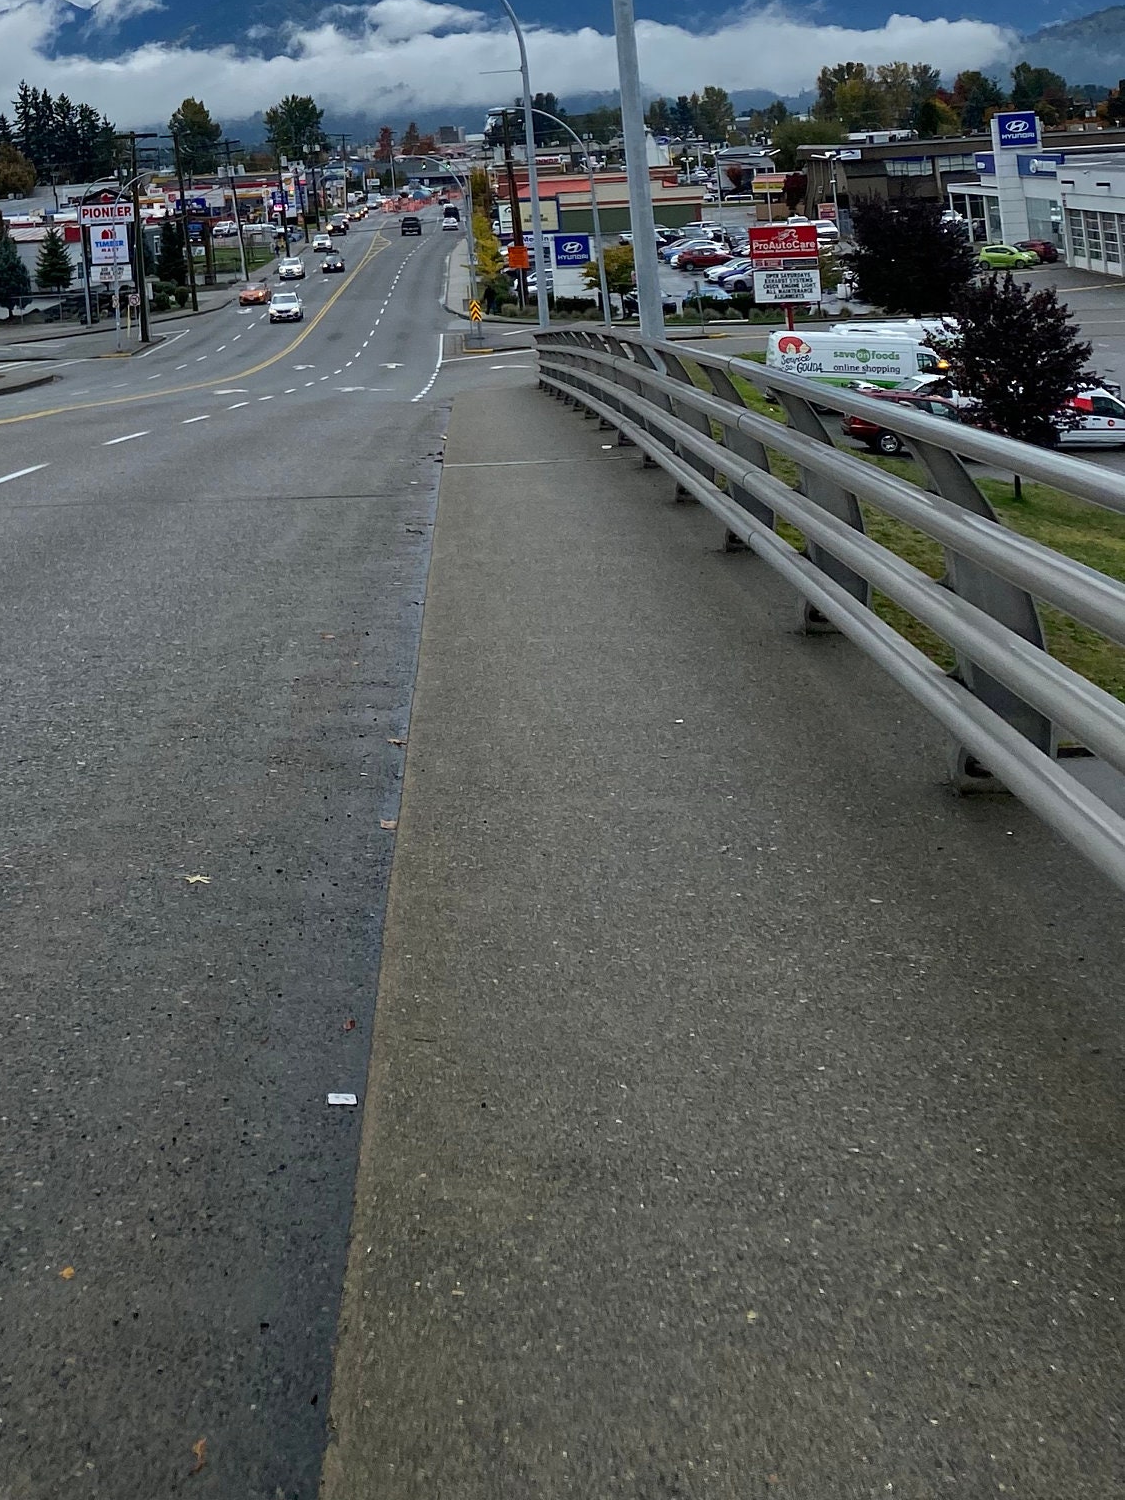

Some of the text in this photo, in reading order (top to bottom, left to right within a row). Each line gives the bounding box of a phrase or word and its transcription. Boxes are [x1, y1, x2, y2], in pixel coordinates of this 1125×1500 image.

[752, 240, 816, 250] ProAutoCare
[781, 354, 811, 365] Service
[871, 350, 900, 360] foods
[797, 363, 823, 373] GOUDA
[862, 365, 901, 374] shopping
